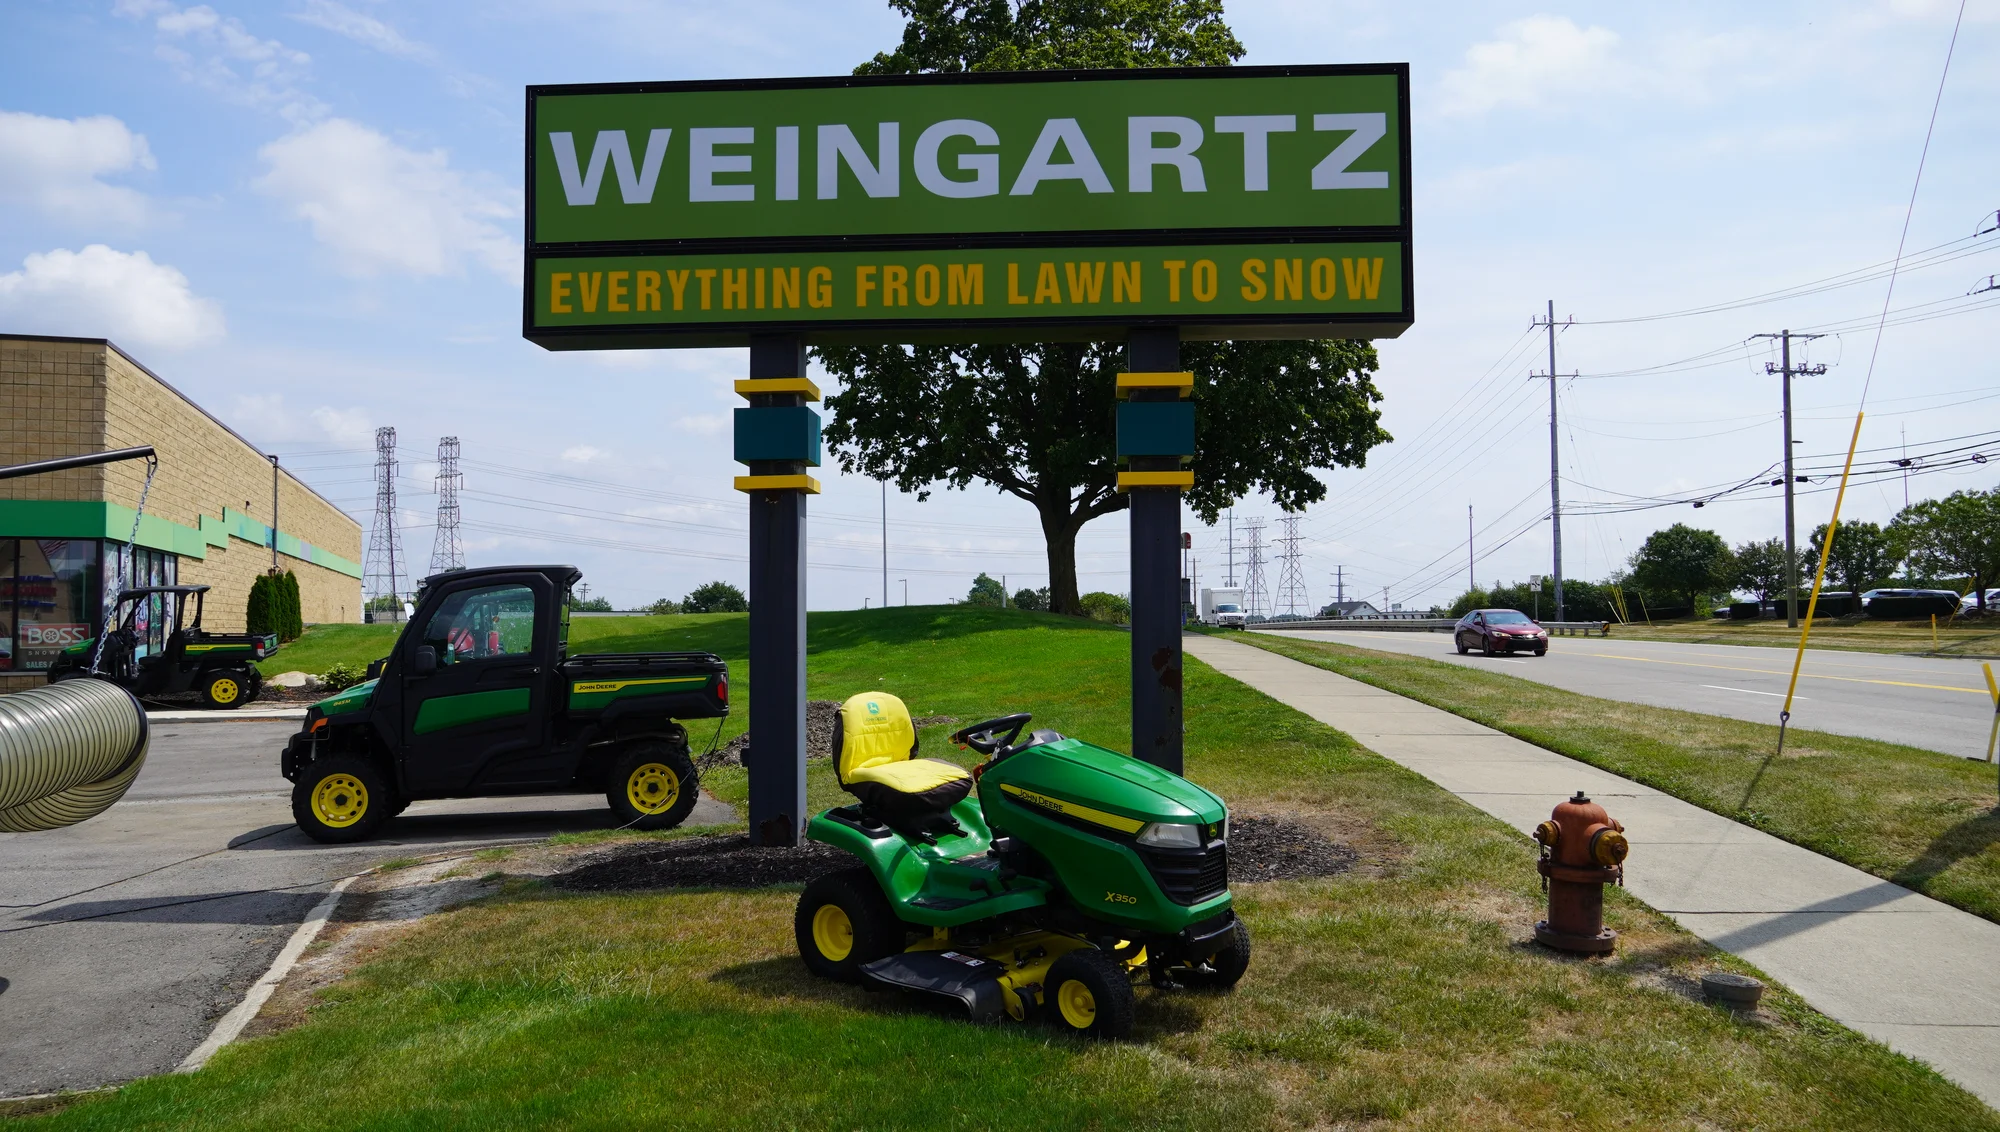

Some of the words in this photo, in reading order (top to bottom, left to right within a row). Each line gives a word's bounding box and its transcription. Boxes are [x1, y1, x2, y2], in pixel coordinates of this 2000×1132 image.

[548, 112, 1390, 206] WEINGARTZ
[550, 266, 833, 314] EVERYTHING
[855, 261, 985, 309] FROM
[1007, 260, 1142, 305] LAWN
[1163, 259, 1219, 303] TO
[1240, 257, 1384, 302] SNOW
[28, 627, 85, 644] BOSS
[26, 661, 48, 669] SALES
[1018, 789, 1038, 804] JOHN
[1038, 796, 1064, 813] DEERE
[1104, 891, 1137, 905] X350
